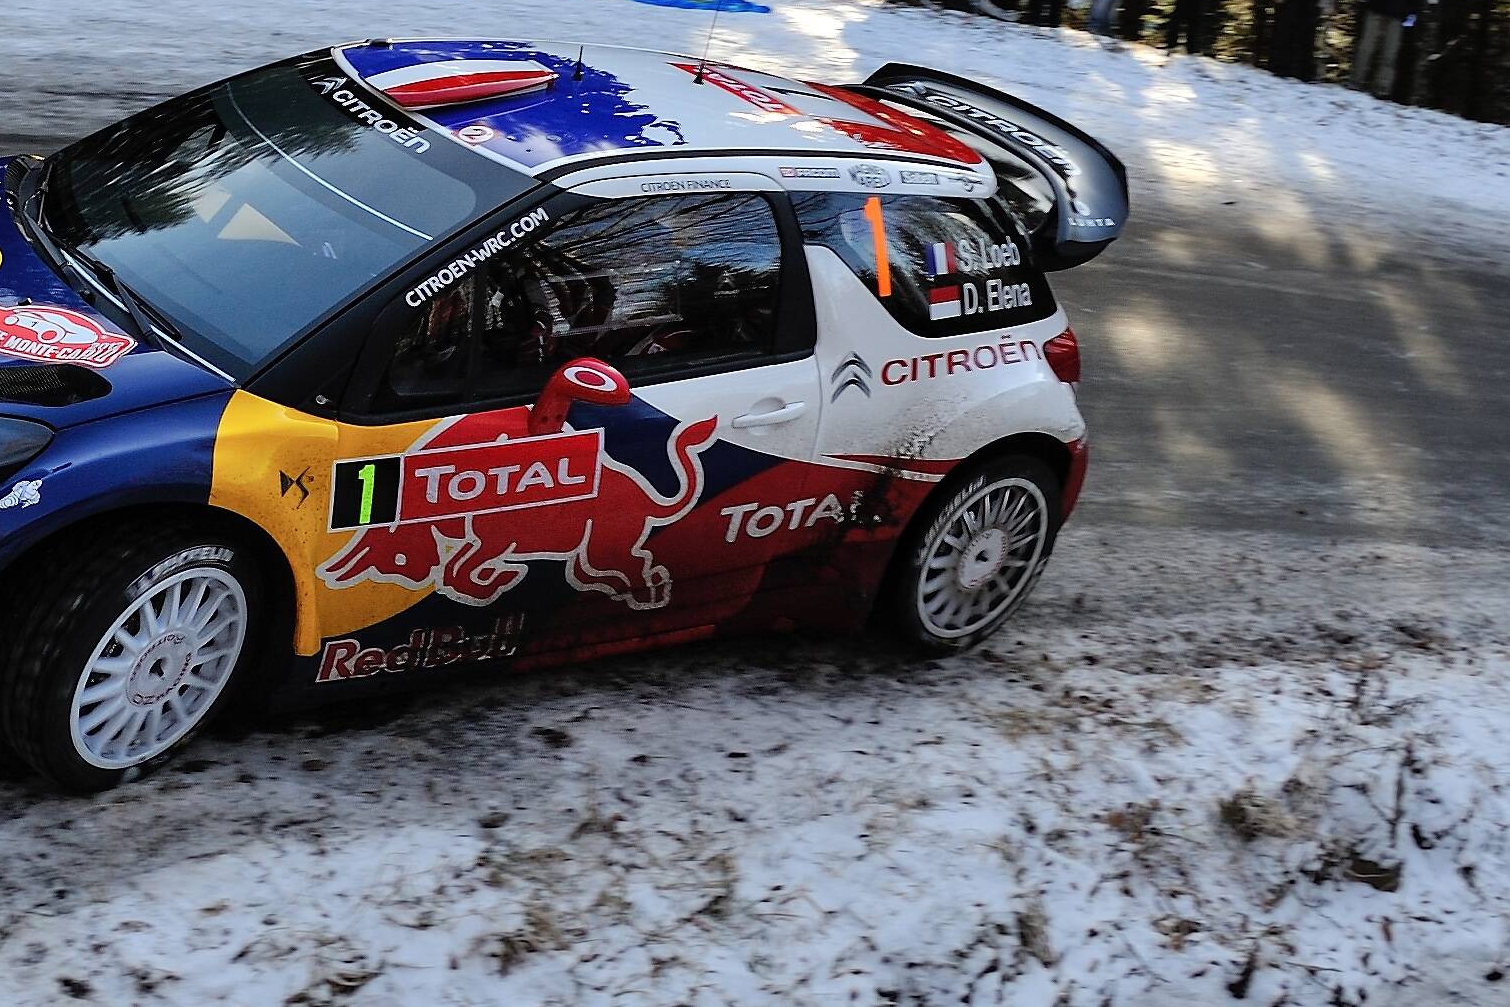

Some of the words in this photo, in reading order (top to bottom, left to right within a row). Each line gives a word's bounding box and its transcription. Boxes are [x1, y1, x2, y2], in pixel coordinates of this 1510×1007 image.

[332, 89, 431, 154] CITROËN
[405, 207, 550, 307] CITROEN-WRC.COM
[863, 197, 892, 297] 1
[979, 235, 1021, 269] Loeb
[963, 282, 984, 315] D.
[986, 279, 1032, 312] Elena
[881, 334, 1042, 386] CITROËN
[358, 464, 375, 524] 1
[415, 457, 586, 504] TOTAL
